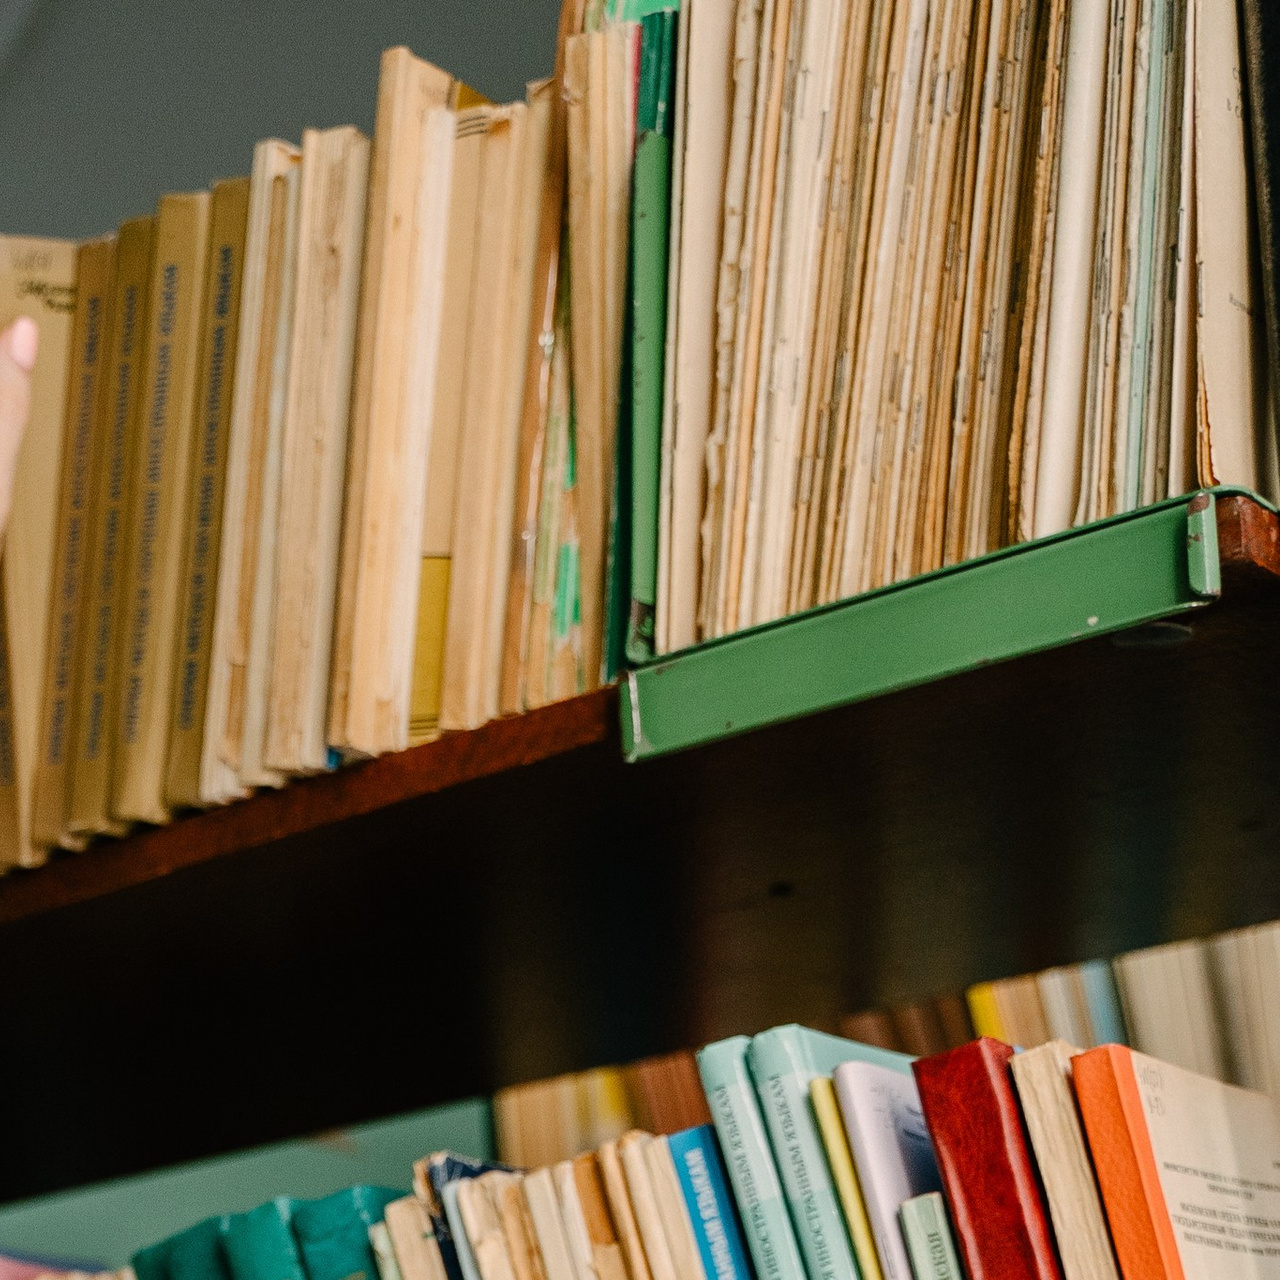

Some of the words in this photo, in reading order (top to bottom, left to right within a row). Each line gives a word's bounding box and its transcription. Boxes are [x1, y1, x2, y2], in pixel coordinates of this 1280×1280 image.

[713, 1081, 746, 1152] ЯЗЫКАМ
[765, 1071, 798, 1143] ЯЗЫКАМ
[683, 1146, 721, 1221] ЯЗЫКАМ
[732, 1151, 780, 1273] ИНОСТРАННЫМ
[785, 1143, 833, 1268] ИНОСТРАННЫМ
